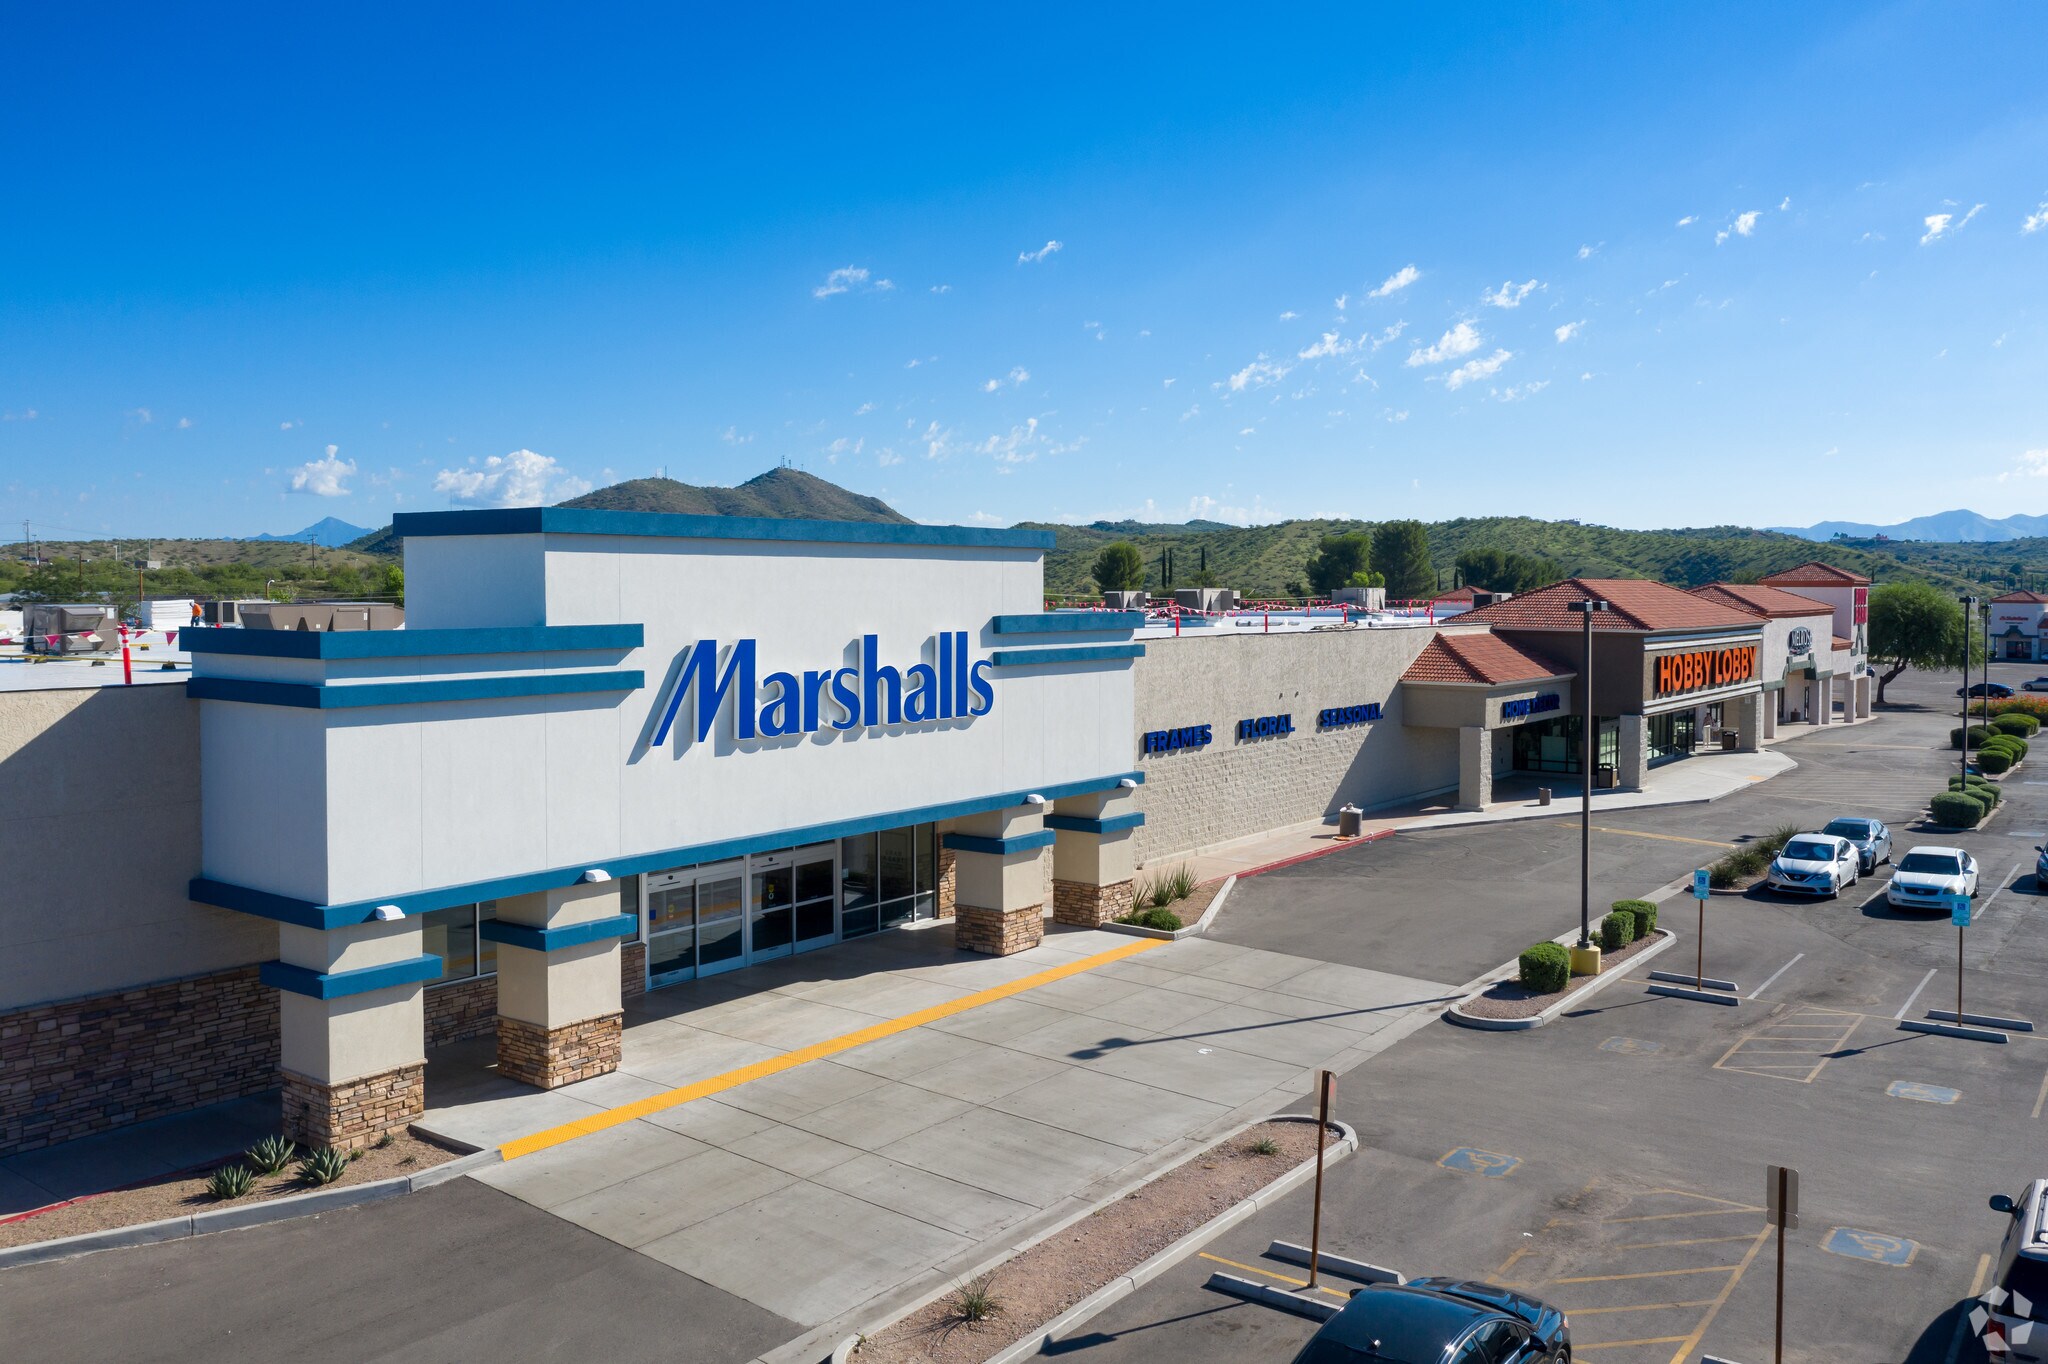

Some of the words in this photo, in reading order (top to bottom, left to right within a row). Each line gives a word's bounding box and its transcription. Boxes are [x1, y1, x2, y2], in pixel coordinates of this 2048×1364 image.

[650, 631, 994, 746] Marshalls
[1660, 650, 1713, 694] HOBBY
[1715, 646, 1757, 684] LOBBY
[1145, 724, 1212, 753] FRAMES
[1240, 714, 1296, 739] FLORAL
[1320, 702, 1384, 727] SEASONAL
[1503, 698, 1531, 718] HOME
